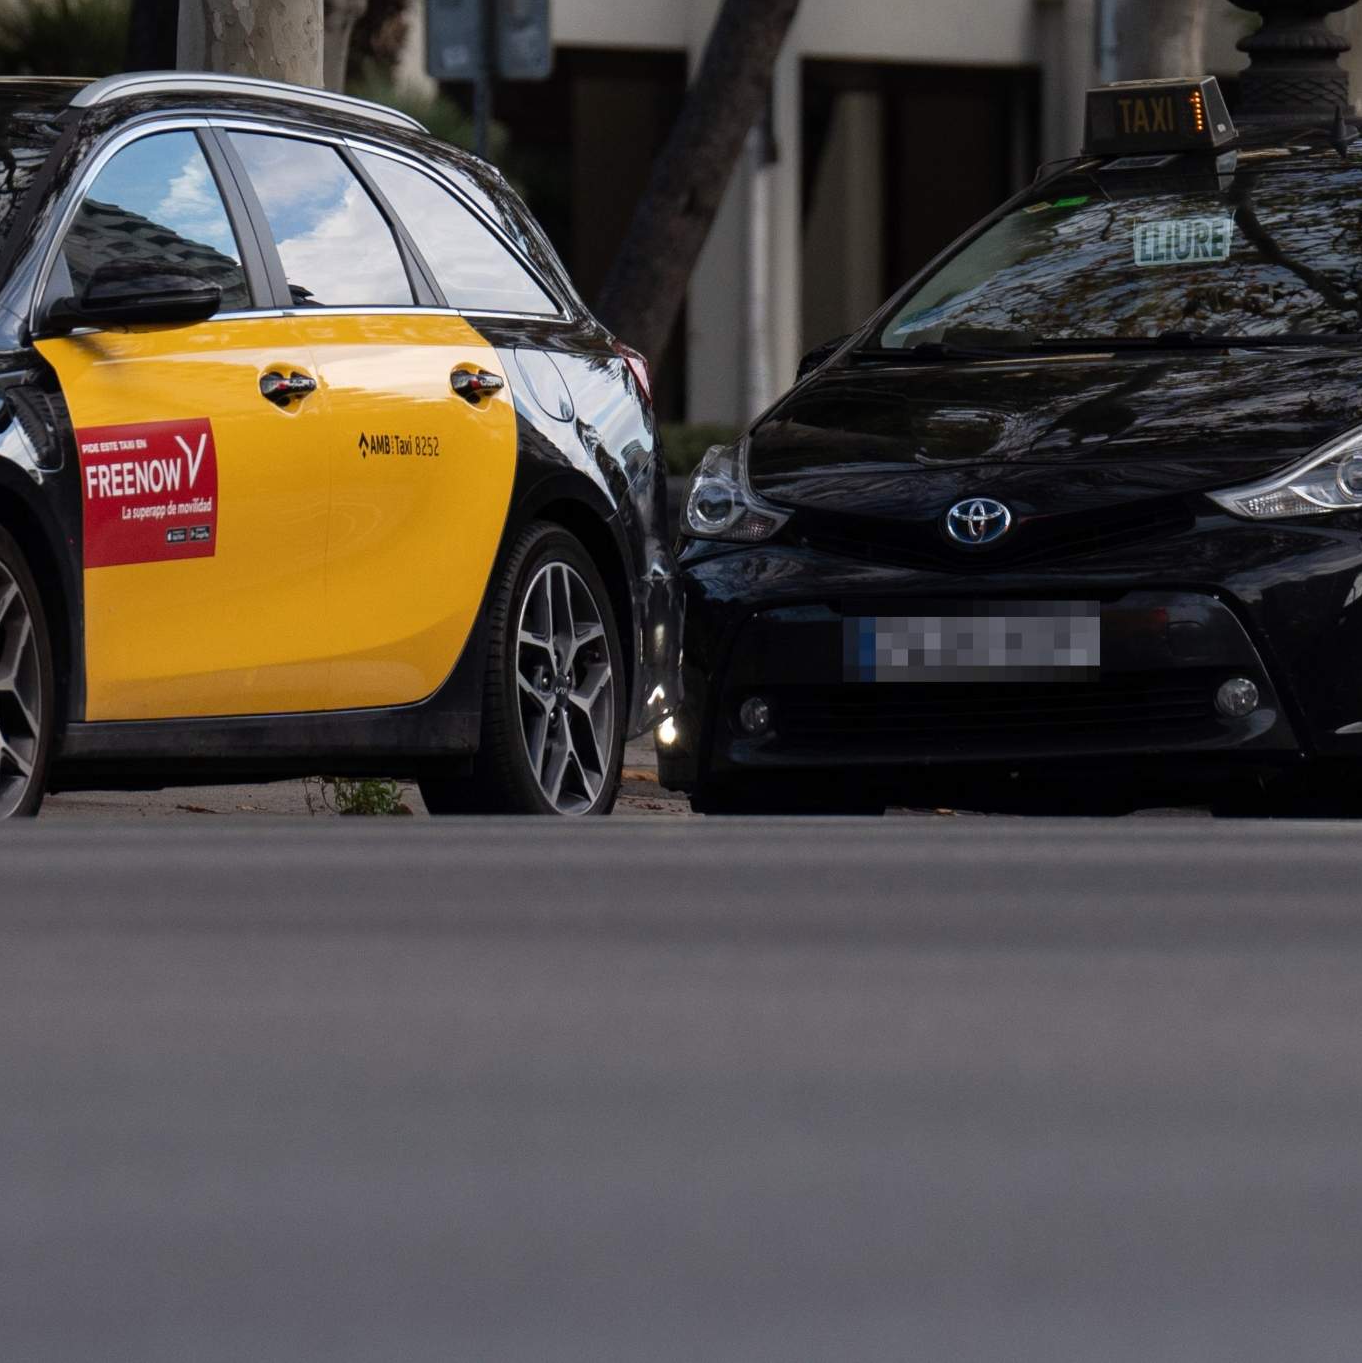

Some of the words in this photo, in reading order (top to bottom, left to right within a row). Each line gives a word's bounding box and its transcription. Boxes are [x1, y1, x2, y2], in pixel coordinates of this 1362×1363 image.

[1118, 96, 1174, 133] TAXI
[1140, 220, 1225, 262] LLIURE
[370, 434, 391, 455] AMB
[394, 434, 413, 455] Taxi
[415, 435, 439, 457] 8252
[86, 458, 182, 500] FREENOW
[122, 506, 132, 520] La
[132, 504, 166, 521] superapp
[167, 500, 177, 516] de
[177, 497, 213, 514] movilidad
